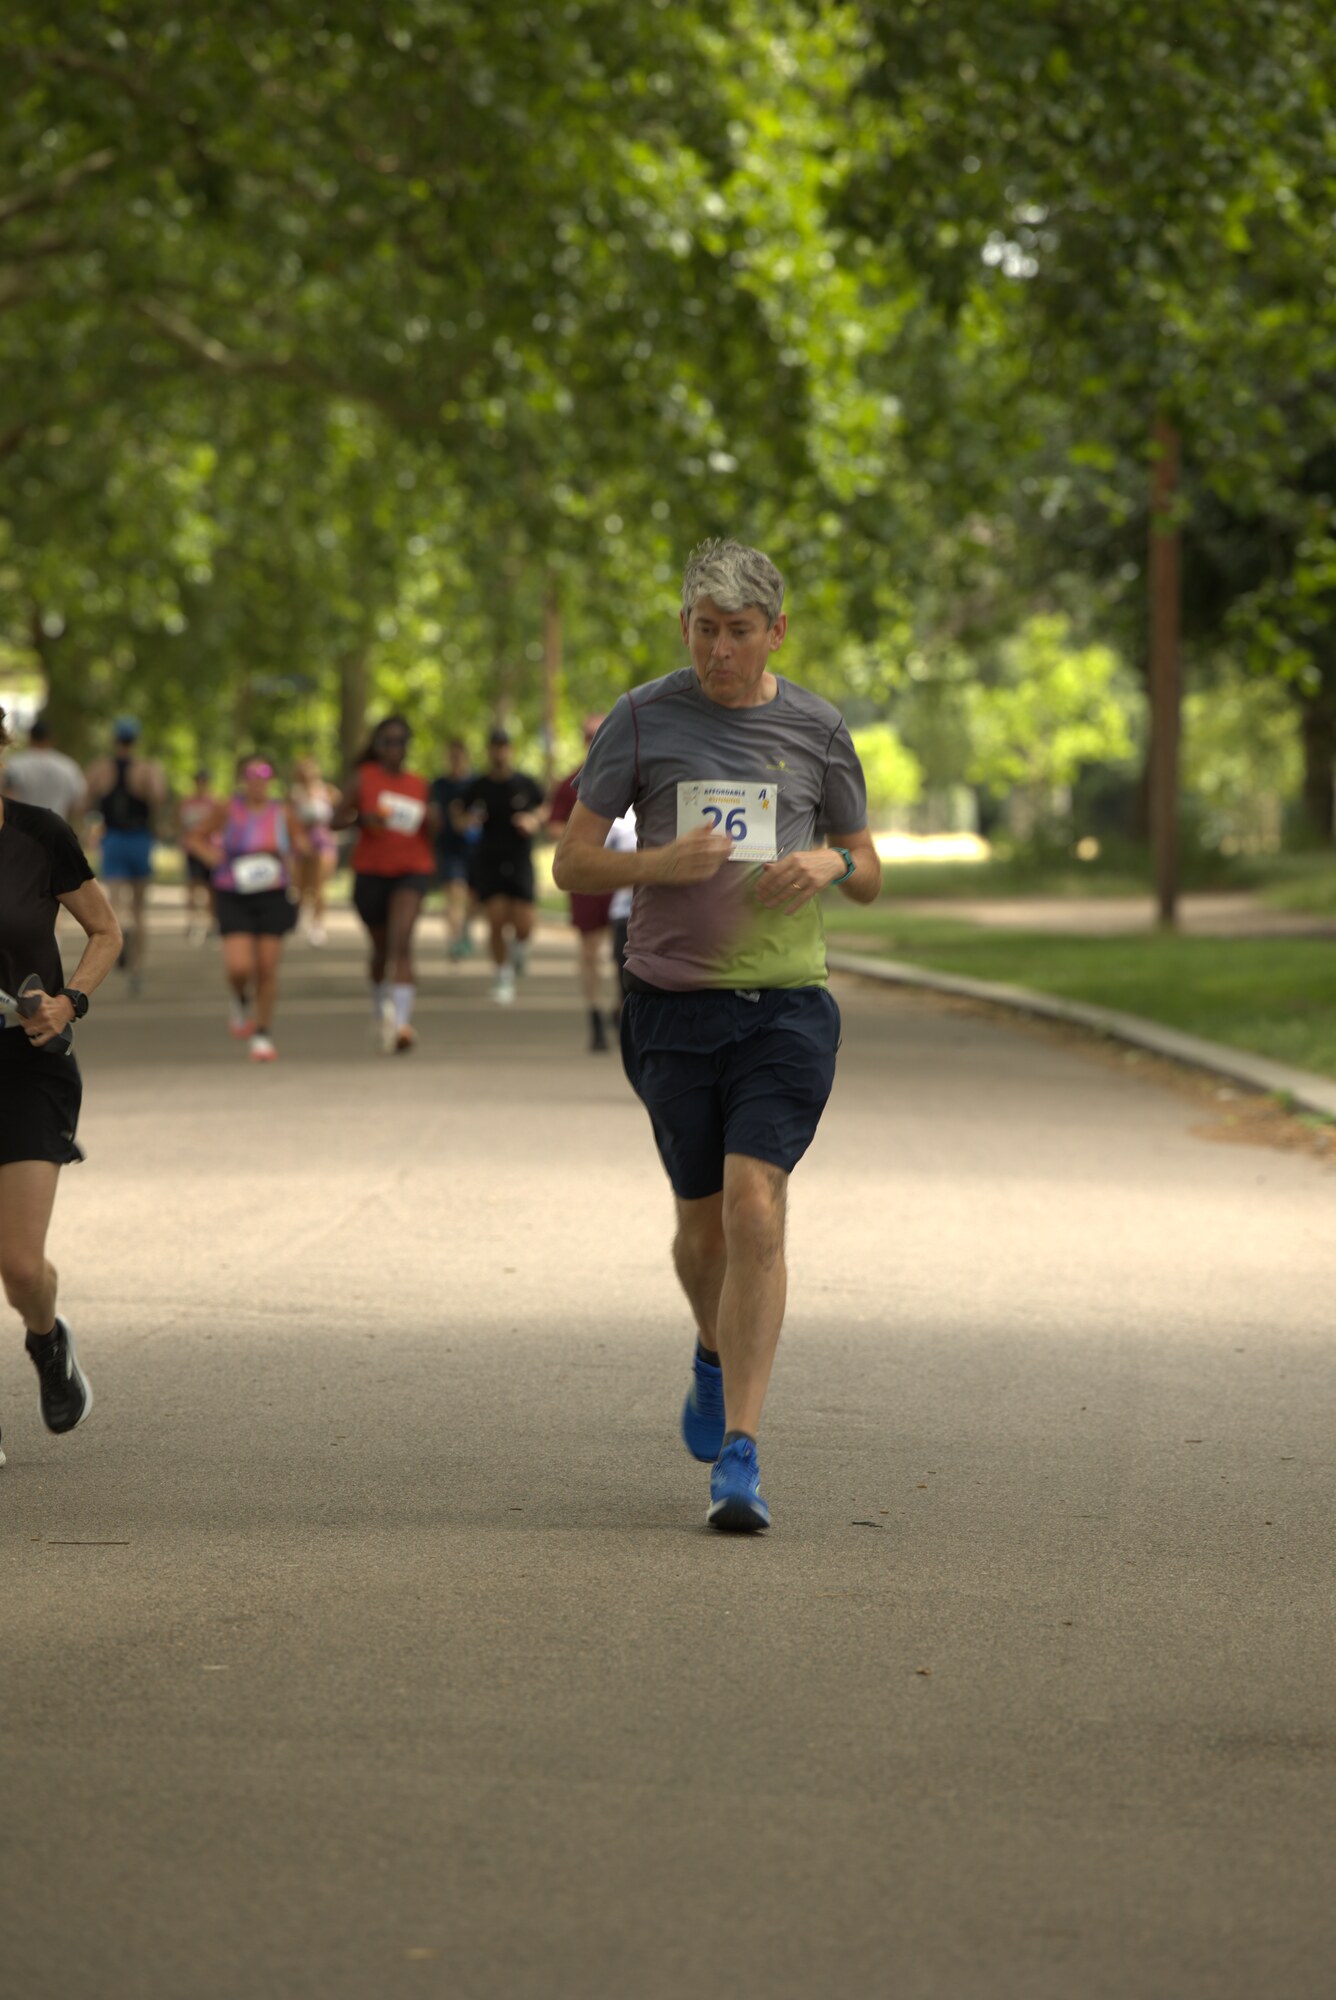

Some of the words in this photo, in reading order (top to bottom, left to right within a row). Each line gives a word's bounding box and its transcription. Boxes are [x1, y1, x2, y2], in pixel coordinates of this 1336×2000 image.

[704, 787, 746, 796] AFFORDABLE
[758, 788, 767, 800] A
[702, 806, 747, 841] 26
